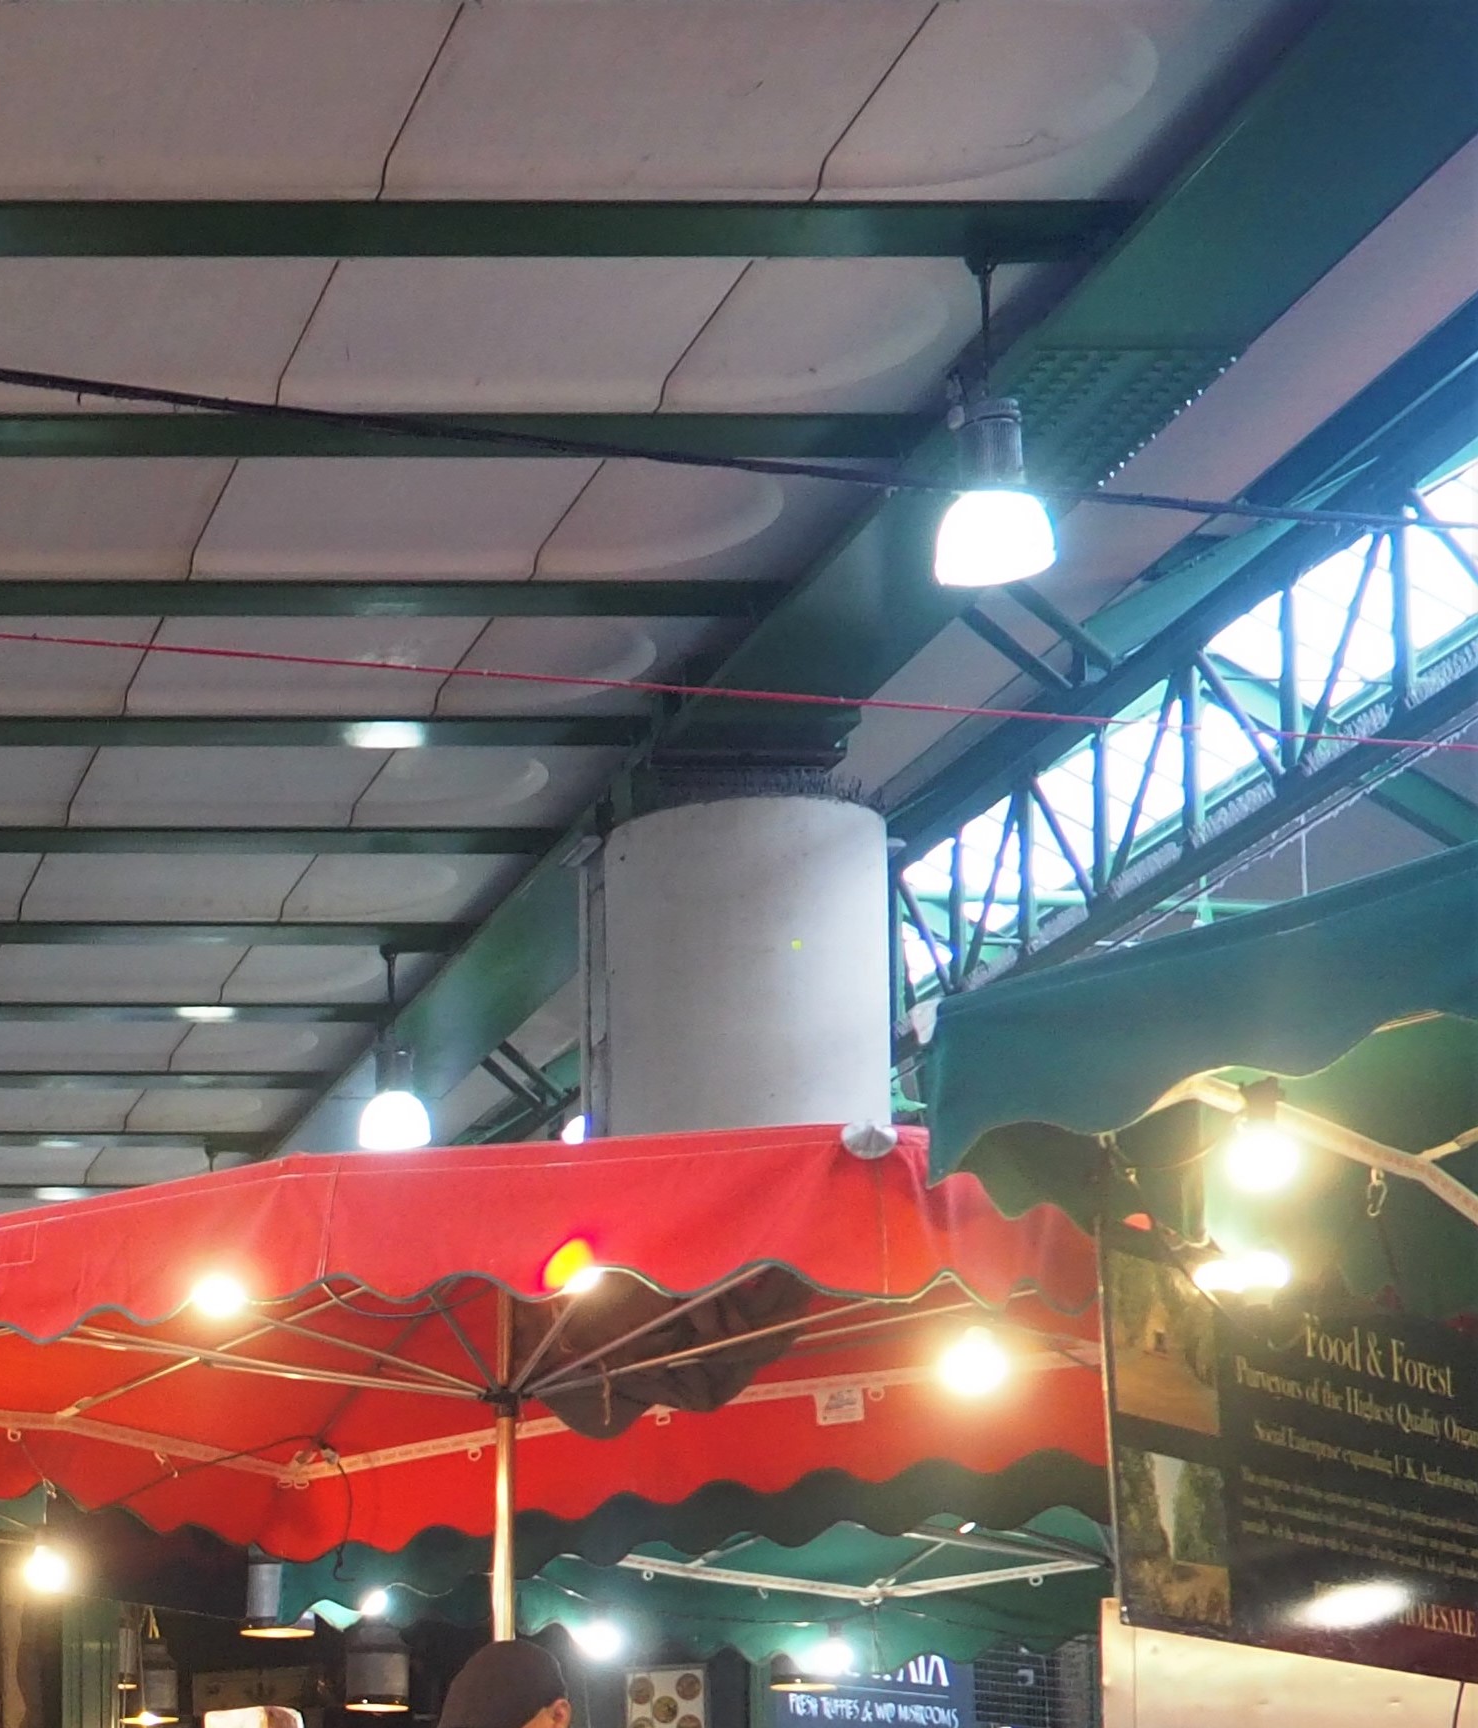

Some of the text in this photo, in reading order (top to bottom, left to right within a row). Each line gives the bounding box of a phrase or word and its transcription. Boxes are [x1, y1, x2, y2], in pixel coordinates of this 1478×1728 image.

[1305, 1322, 1455, 1399] Food & Forest
